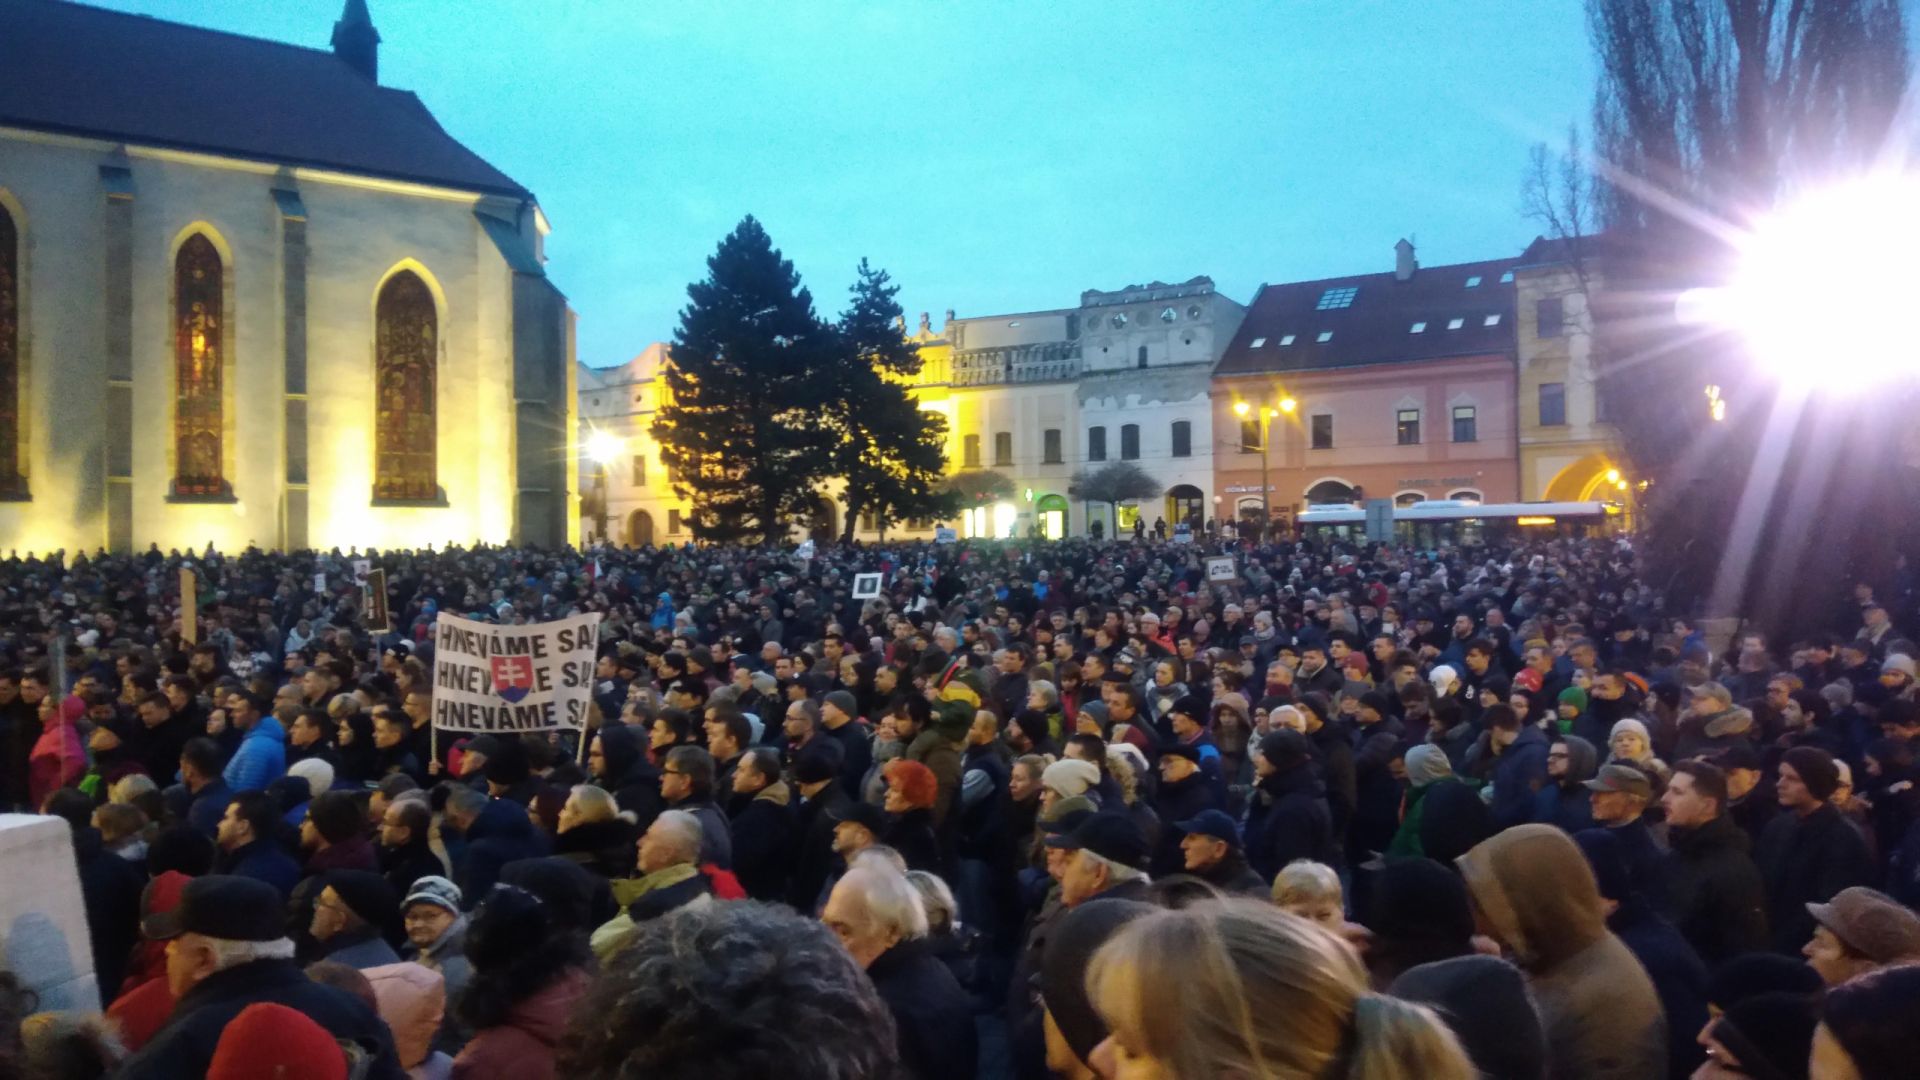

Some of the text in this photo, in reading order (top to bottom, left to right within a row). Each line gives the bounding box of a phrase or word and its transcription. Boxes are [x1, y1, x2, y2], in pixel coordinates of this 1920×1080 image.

[440, 623, 548, 660] HNEVÁME
[437, 660, 553, 696] HNEVE
[436, 698, 558, 730] HNEVÁME
